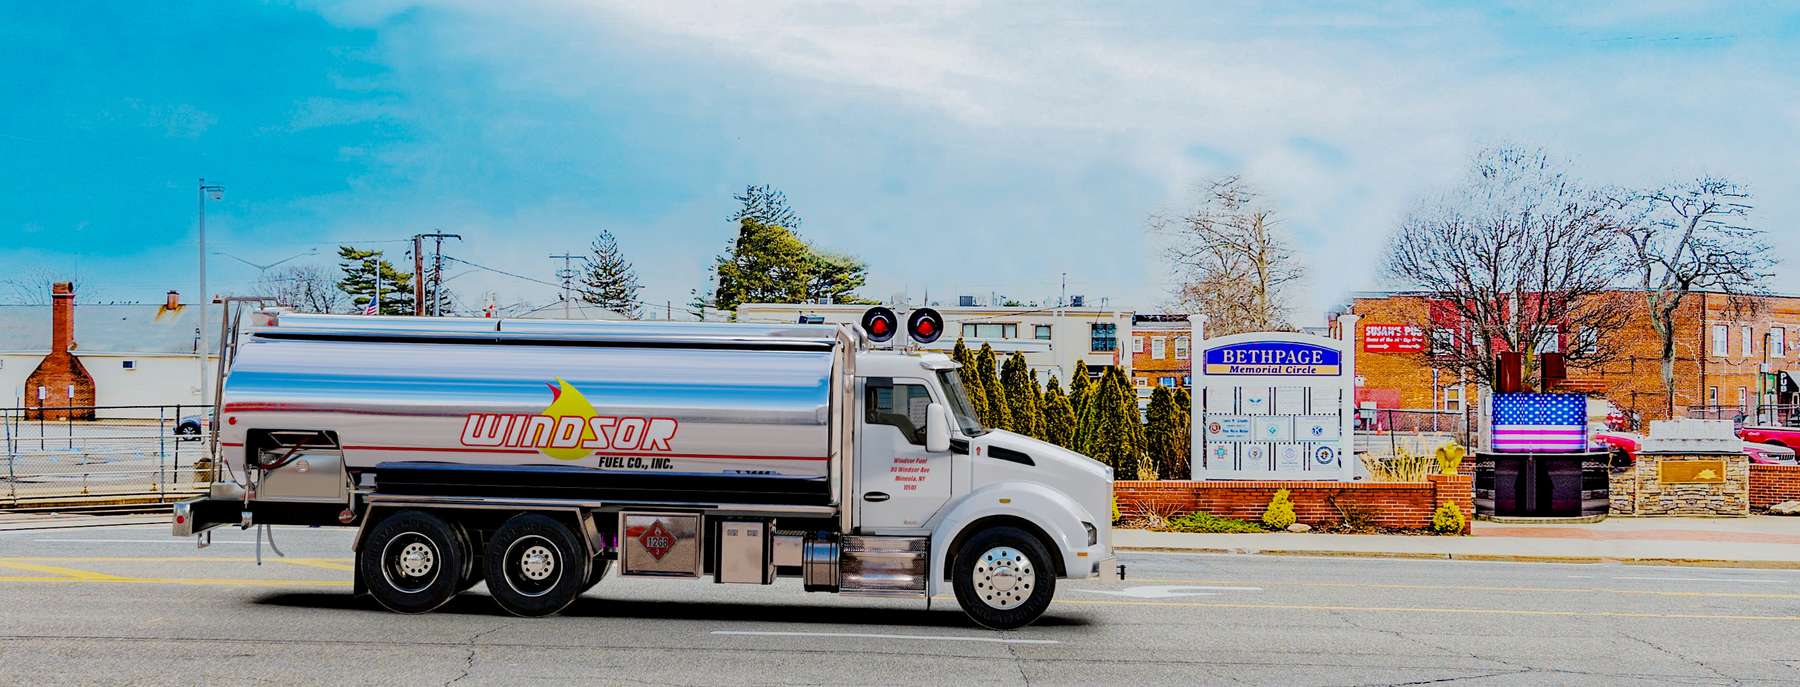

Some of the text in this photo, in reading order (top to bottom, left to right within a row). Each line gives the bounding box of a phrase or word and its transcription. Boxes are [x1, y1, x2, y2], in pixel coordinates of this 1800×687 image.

[1222, 349, 1324, 364] BETHPAGE
[1229, 365, 1317, 374] Memorial Circle
[460, 413, 679, 451] WINDSOR
[598, 456, 674, 470] FUEL CO., INC.
